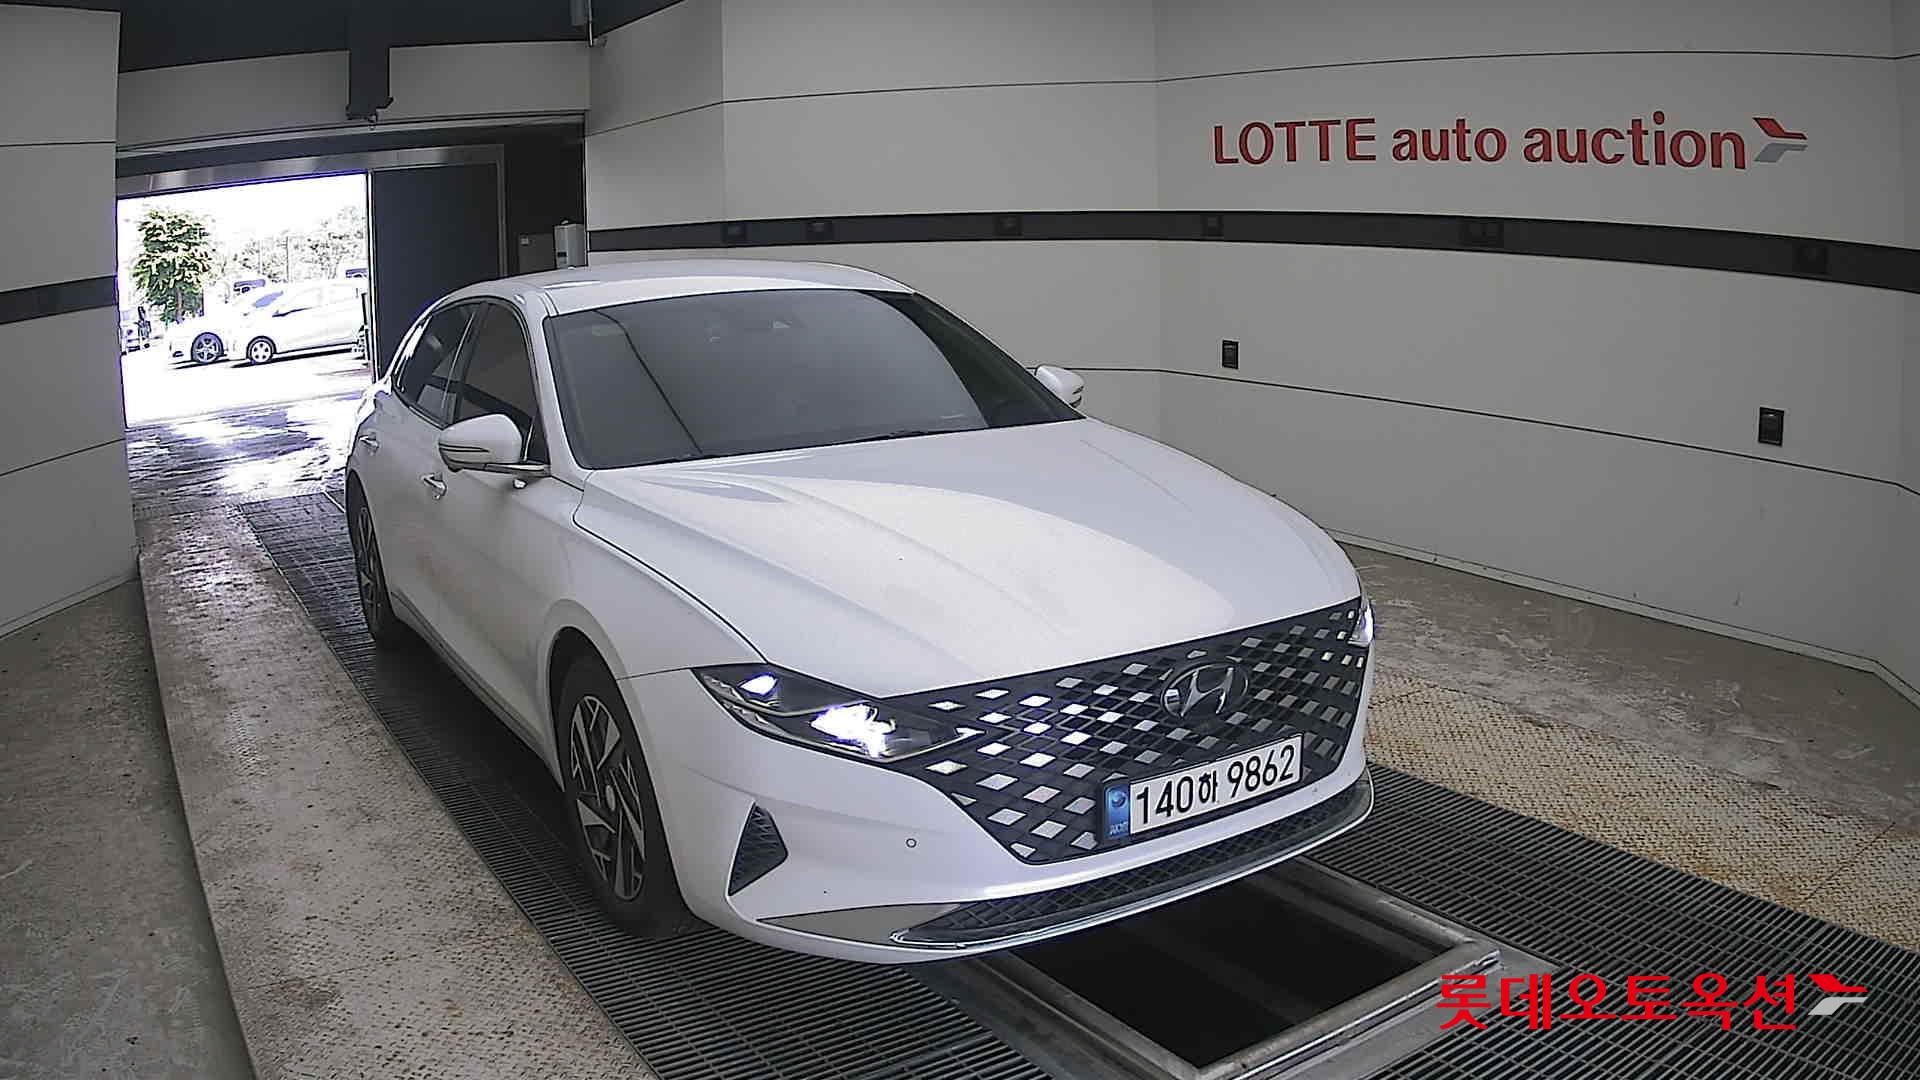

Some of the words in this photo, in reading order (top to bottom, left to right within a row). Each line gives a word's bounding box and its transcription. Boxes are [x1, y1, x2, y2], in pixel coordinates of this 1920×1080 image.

[1212, 117, 1377, 165] LOTTE
[1392, 118, 1508, 163] auto
[1523, 111, 1747, 169] auction
[1136, 770, 1218, 825] 140하
[1227, 744, 1296, 799] 9862
